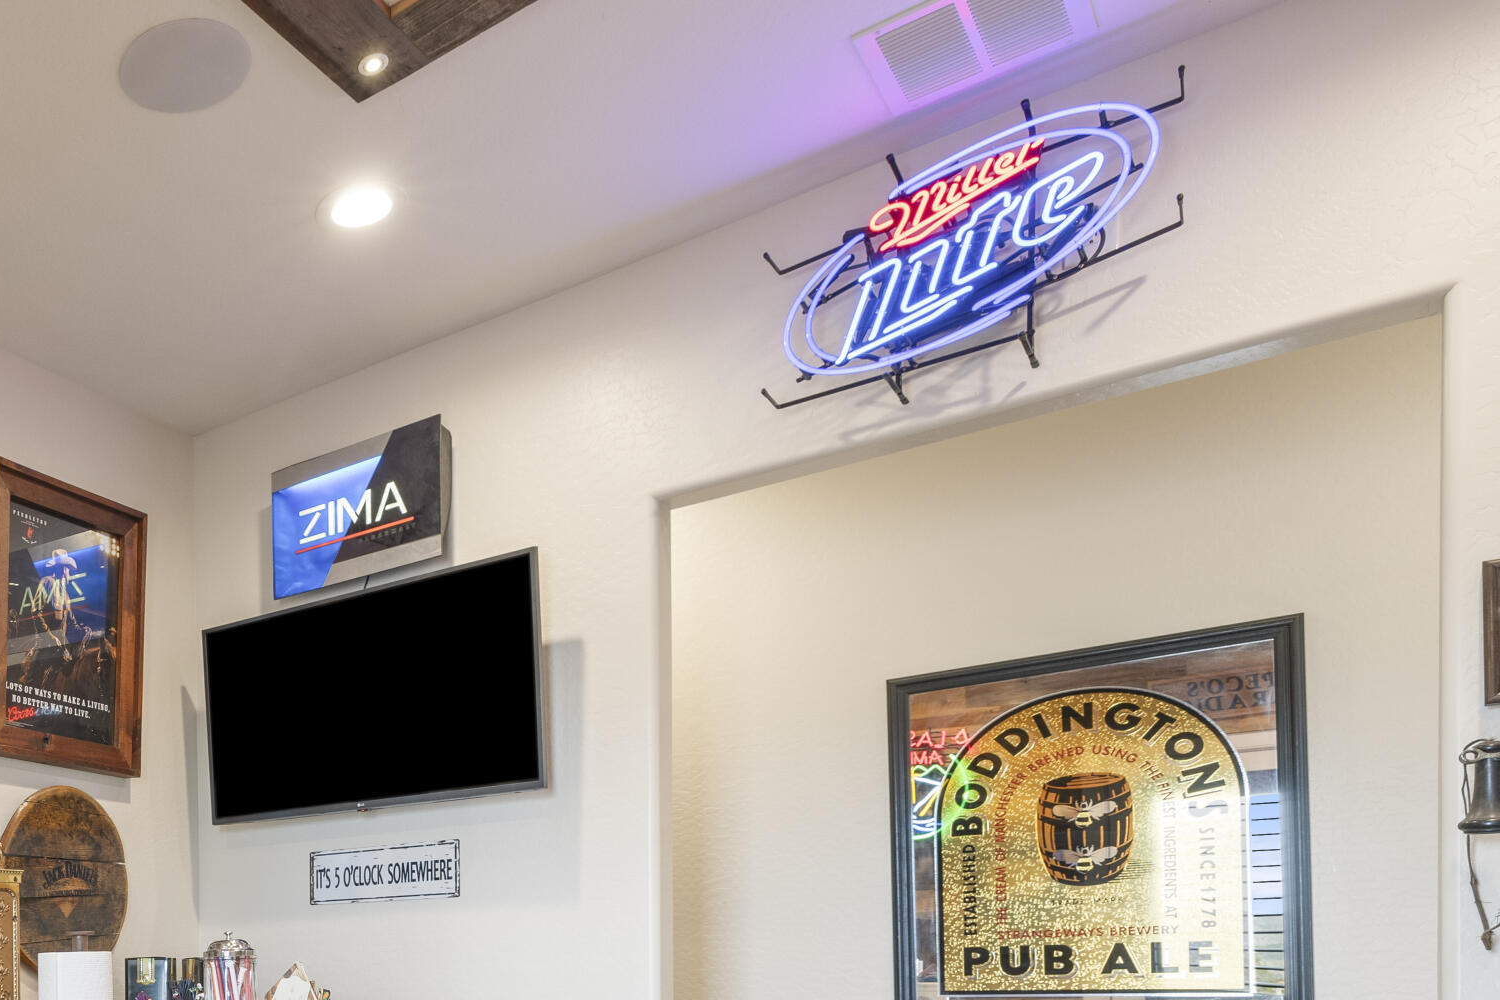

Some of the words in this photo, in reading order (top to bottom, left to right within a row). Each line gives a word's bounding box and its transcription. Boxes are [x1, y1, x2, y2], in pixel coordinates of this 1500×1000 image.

[869, 138, 1045, 251] Miller
[837, 152, 1105, 366] Lite
[299, 481, 408, 544] ZIMA
[5, 681, 23, 693] LOTS
[24, 685, 32, 695] OF
[34, 687, 52, 699] WAYS
[53, 692, 61, 701] TO
[63, 695, 80, 706] MAKE
[81, 699, 86, 707] A
[12, 694, 21, 704] NO
[23, 695, 49, 709] BETTER
[50, 703, 63, 713] WAY
[65, 706, 73, 715] TO
[74, 709, 91, 719] LIVE.
[7, 706, 36, 722] Coors
[952, 702, 1229, 837] BODDINGTONS
[1027, 745, 1084, 772] BREWED
[1092, 745, 1139, 764] USING
[1139, 761, 1164, 782] THE
[995, 771, 1027, 844] MANCHESTER
[1156, 782, 1176, 820] FINEST
[995, 849, 1006, 862] OF
[1163, 826, 1178, 901] INGREDIENTS
[1199, 827, 1216, 881] SINCE
[315, 867, 331, 889] IT'S
[334, 867, 340, 888] 5
[344, 864, 384, 887] O'CLOCK
[387, 858, 453, 884] SOMEWHERE
[963, 844, 977, 936] ESTABLISHED
[995, 868, 1007, 902] CREAM
[1164, 906, 1178, 919] AT
[1201, 886, 1217, 929] 1778
[997, 926, 1104, 940] STRANGEWAYS
[1110, 925, 1179, 937] BREWERY
[963, 945, 1077, 976] PUB
[1101, 941, 1213, 975] ALE
